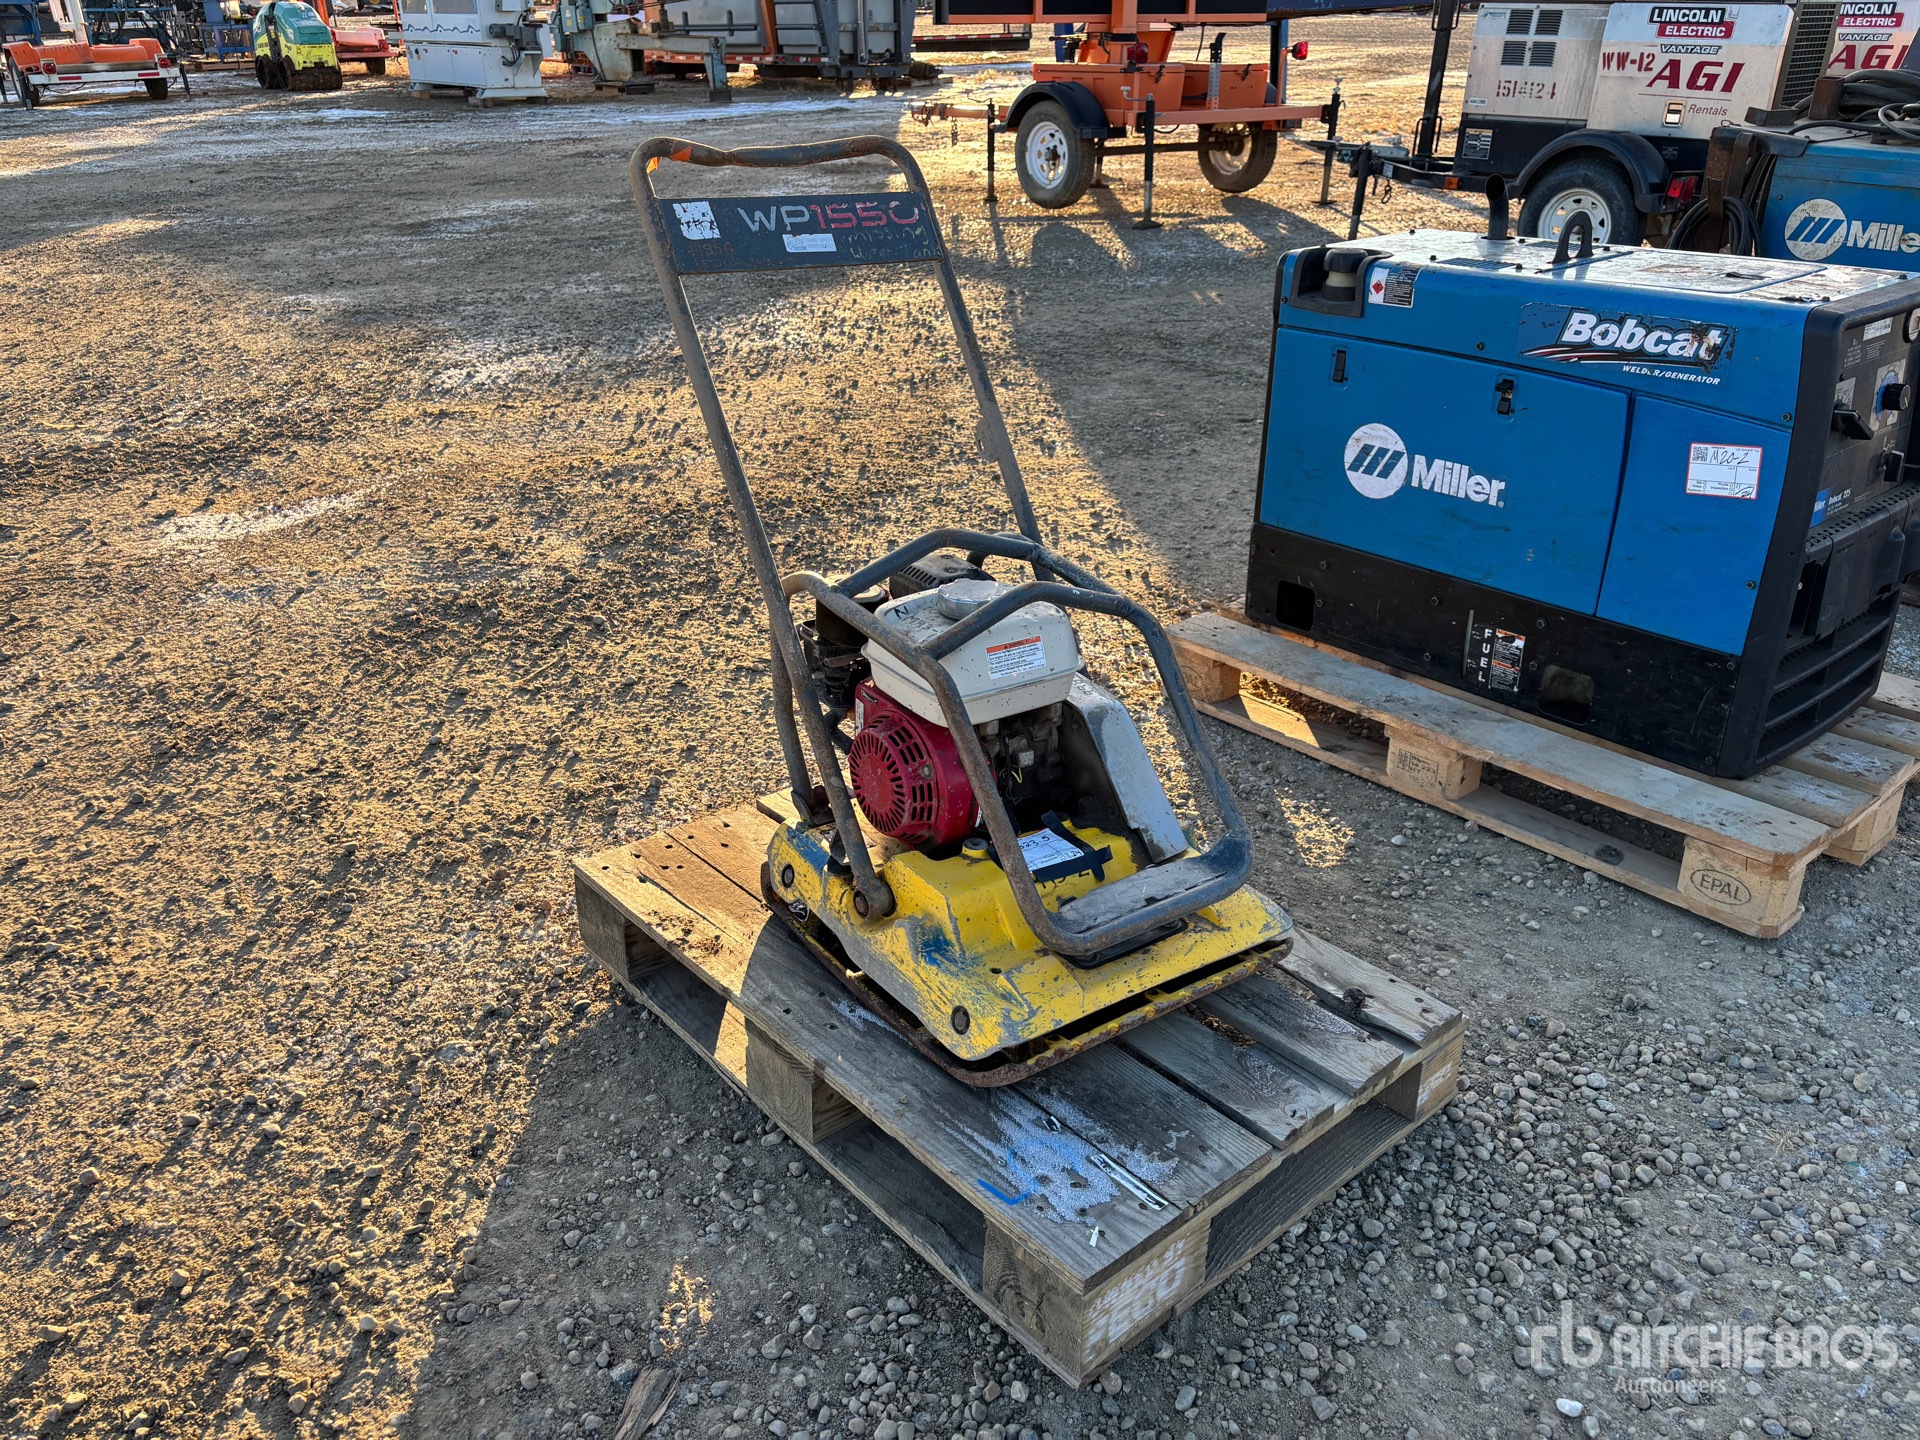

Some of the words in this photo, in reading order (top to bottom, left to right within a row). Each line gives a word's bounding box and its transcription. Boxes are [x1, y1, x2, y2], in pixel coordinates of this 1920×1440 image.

[1653, 9, 1722, 22] LINCOLN
[1840, 4, 1893, 15] INCOLN
[1665, 26, 1726, 37] ELECTRIC
[1843, 18, 1896, 26] ELECTRIC
[1839, 33, 1890, 41] VANTAGE
[1661, 45, 1719, 54] VANTAGE
[1827, 45, 1909, 69] AGI
[1602, 52, 1656, 73] WW-12
[1645, 59, 1746, 93] AGI
[1688, 104, 1728, 116] Rentals
[737, 201, 919, 232] WP1550
[1846, 220, 1920, 254] Mille
[1561, 312, 1723, 361] Bobcat
[1411, 454, 1506, 507] Miller
[1478, 628, 1493, 682] FUEL
[1699, 873, 1742, 902] EPAL
